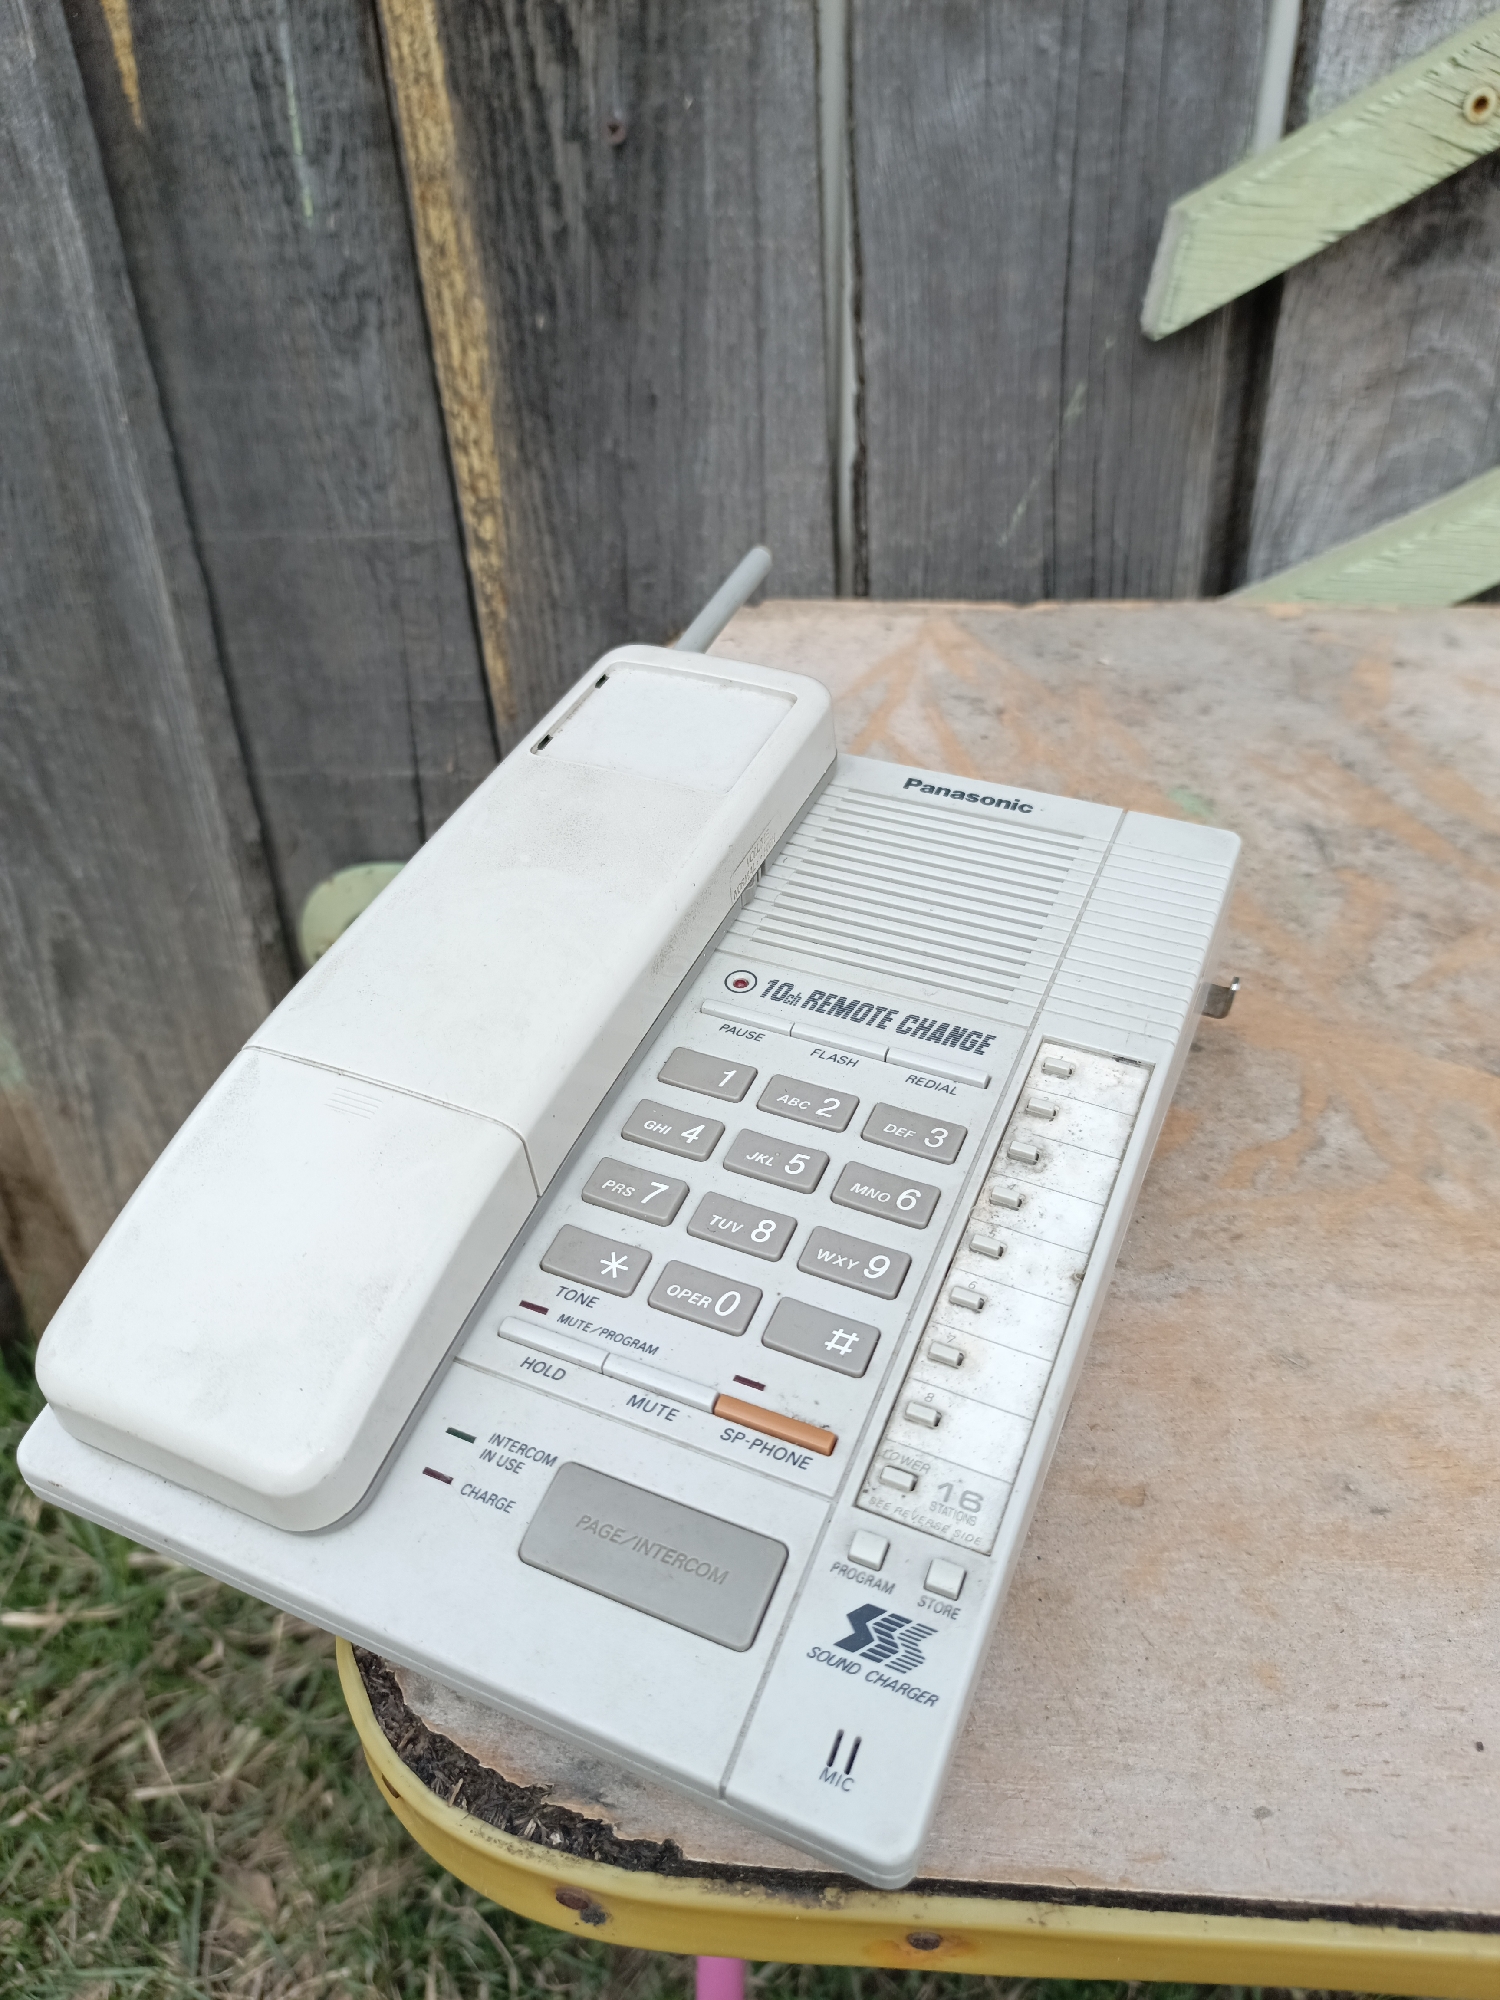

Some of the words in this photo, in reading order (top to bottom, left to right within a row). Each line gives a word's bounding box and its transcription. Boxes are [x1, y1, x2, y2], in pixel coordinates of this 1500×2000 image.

[903, 777, 1034, 814] Panasonic
[719, 1023, 765, 1043] PAUSE
[801, 990, 898, 1030] REMOTE
[896, 1014, 997, 1056] CHANGE
[810, 1048, 859, 1068] FLASH
[718, 1070, 734, 1087] 1
[905, 1074, 957, 1096] REDIAL
[777, 1095, 811, 1110] ABC
[815, 1097, 841, 1118] 2
[643, 1119, 673, 1135] GHI
[681, 1124, 706, 1145] 4
[883, 1123, 916, 1139] DEF
[924, 1127, 949, 1149] 3
[746, 1151, 774, 1168] JKL
[784, 1153, 810, 1175] 5
[601, 1178, 636, 1198] PRS
[640, 1180, 669, 1204] 7
[850, 1182, 891, 1203] MNO
[896, 1188, 922, 1211] 6
[709, 1214, 744, 1234] TUV
[750, 1218, 777, 1244] 8
[817, 1247, 860, 1271] WXY
[863, 1254, 891, 1280] 9
[555, 1285, 600, 1310] TONE
[666, 1284, 712, 1309] OPER
[714, 1290, 741, 1317] 0
[557, 1313, 659, 1356] MUTE/PROGRAM
[520, 1356, 567, 1382] HOLD
[625, 1394, 680, 1422] MUTE
[479, 1447, 495, 1463] IN
[496, 1452, 526, 1476] USE
[488, 1431, 558, 1468] INTERCOM
[720, 1428, 813, 1471] SP-PHONE
[882, 1449, 931, 1475] LOWER
[460, 1483, 517, 1514] CHARGE
[937, 1482, 984, 1514] 16
[868, 1496, 892, 1511] SEE
[894, 1506, 951, 1534] REVERSE
[953, 1529, 983, 1546] SIDE
[929, 1501, 977, 1527] STATIONS
[576, 1514, 730, 1587] PAGE/INTERCOM
[830, 1561, 896, 1595] PROGRAM
[917, 1595, 961, 1620] STORE
[806, 1646, 862, 1675] SOUND
[864, 1671, 939, 1707] CHARGER
[818, 1766, 855, 1793] MIC
